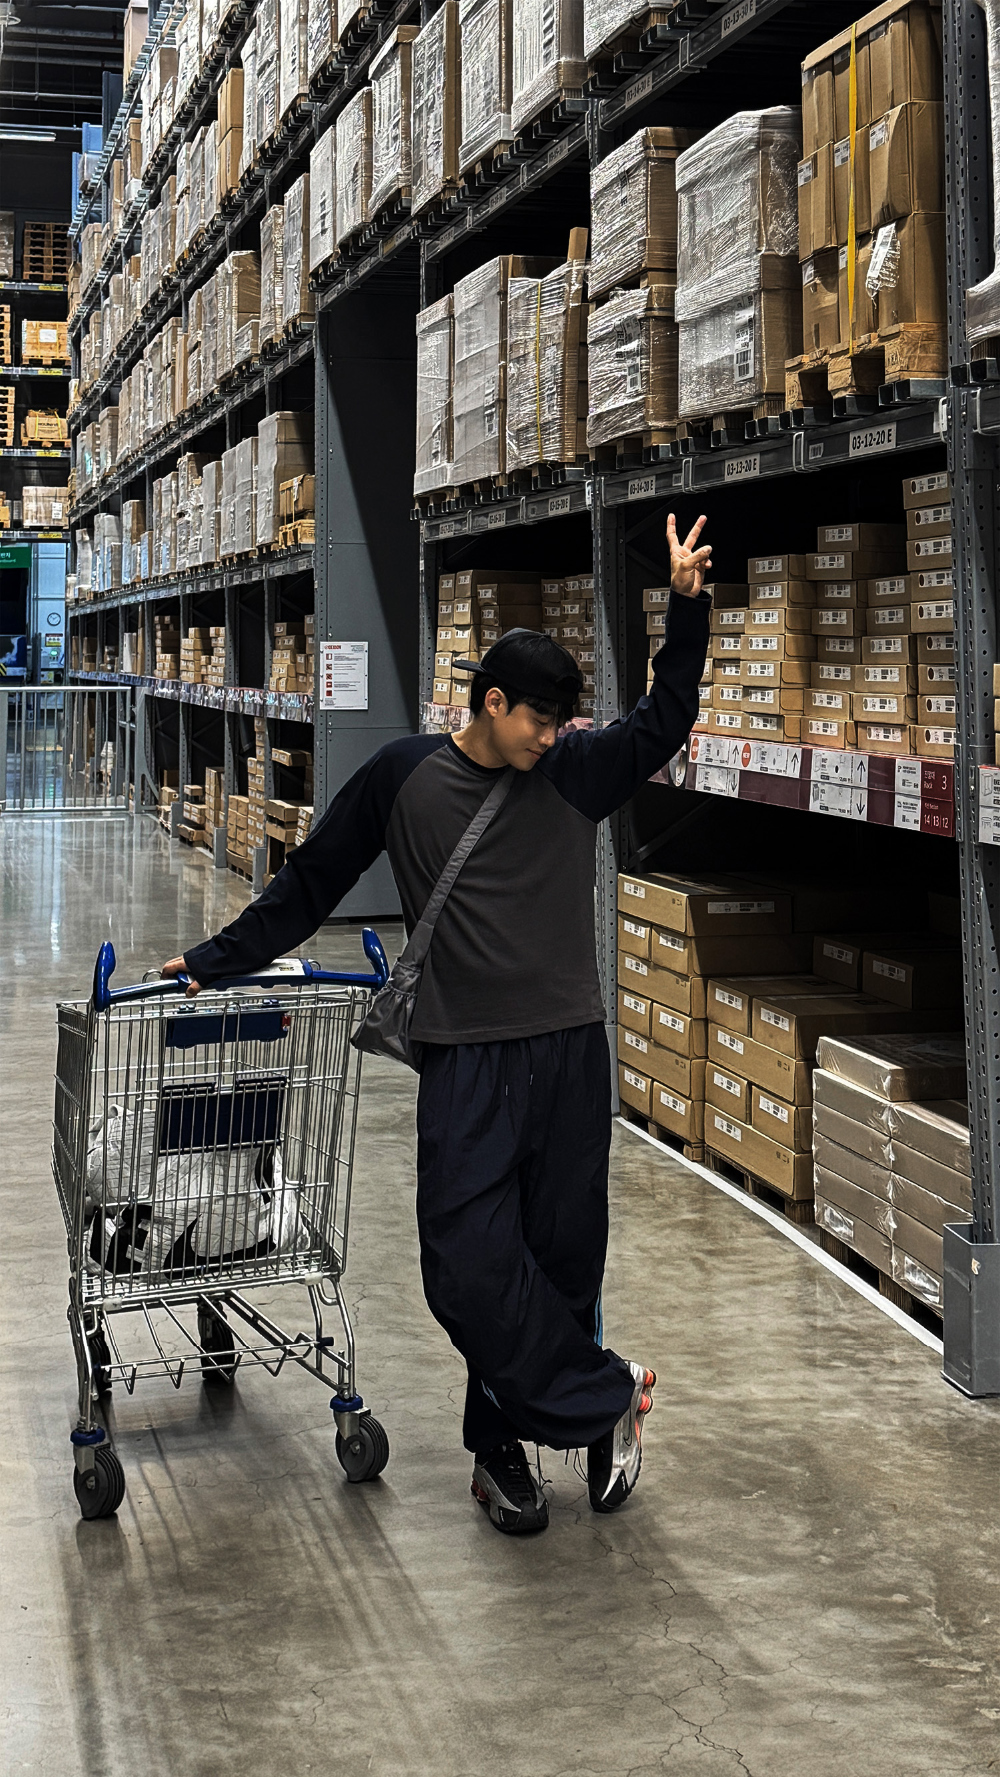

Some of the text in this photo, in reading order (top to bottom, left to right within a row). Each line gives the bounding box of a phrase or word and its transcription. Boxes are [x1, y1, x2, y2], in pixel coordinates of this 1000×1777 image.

[723, 3, 749, 31] 03-13-30
[851, 428, 893, 451] 03-12-20 E
[726, 458, 757, 476] 03-13-20 E
[629, 481, 649, 496] 03-14-20
[941, 775, 948, 791] 3
[924, 814, 949, 829] 14 13 12
